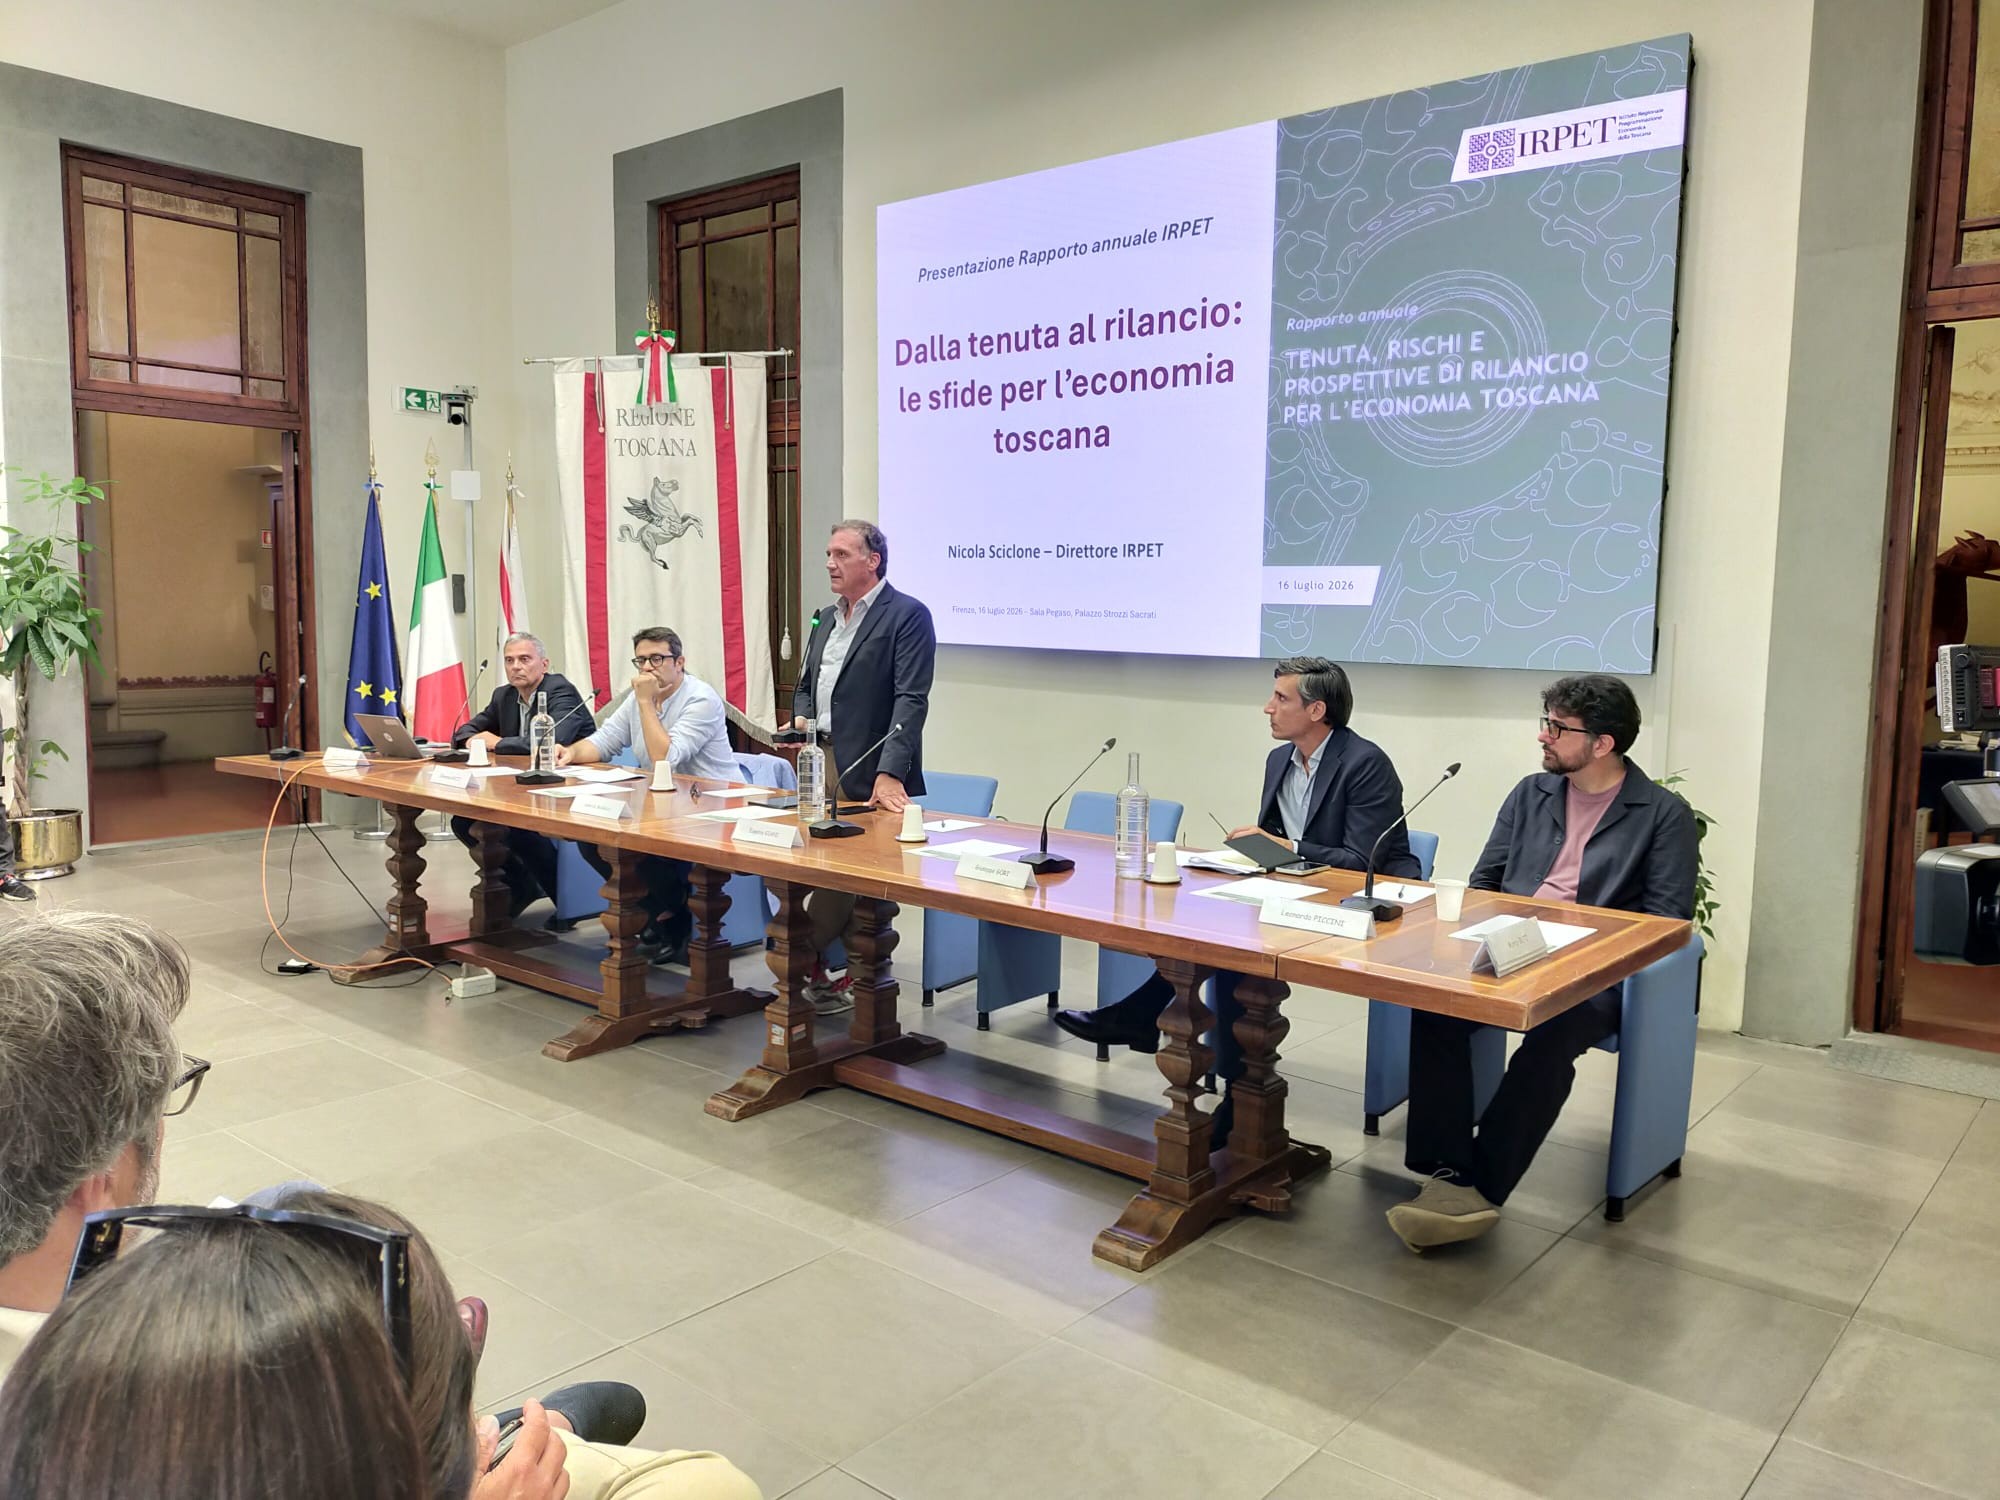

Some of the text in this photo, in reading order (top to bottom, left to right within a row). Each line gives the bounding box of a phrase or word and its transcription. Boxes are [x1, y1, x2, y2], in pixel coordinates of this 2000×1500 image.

[1517, 116, 1617, 158] IRPET
[917, 216, 1214, 283] Presentazione Rapporto annuale IRPET
[895, 297, 1242, 367] Dalla tenuta al rilancio:
[1286, 303, 1420, 333] Rapporto annuale
[1284, 330, 1485, 370] TENUTA, RISCHI E
[1284, 351, 1589, 397] PROSPETTIVE DI RILANCIO
[899, 386, 921, 413] le
[928, 379, 993, 411] sfide
[1000, 379, 1047, 411] per
[1283, 404, 1322, 424] PER
[1479, 381, 1600, 410] TOSCANA
[616, 407, 696, 427] REGIONE
[614, 437, 697, 457] TOSCANA
[993, 424, 1110, 454] toscana
[948, 544, 985, 559] Nicola
[988, 543, 1041, 559] Sciclone
[1056, 543, 1118, 559] Direttore
[1122, 542, 1164, 558] IRPET
[1278, 580, 1354, 592] 16 luglio 2026
[952, 605, 977, 615] Firenze,
[978, 606, 986, 615] 16
[987, 606, 1005, 616] luglio
[1006, 607, 1023, 616] 2026
[1029, 607, 1045, 616] Sala
[1046, 608, 1073, 618] Pegaso,
[1074, 608, 1103, 618] Palazzo
[1103, 609, 1129, 618] Strozzi
[1129, 609, 1157, 619] Sacrati
[1280, 907, 1345, 928] Leonardo PICCINI
